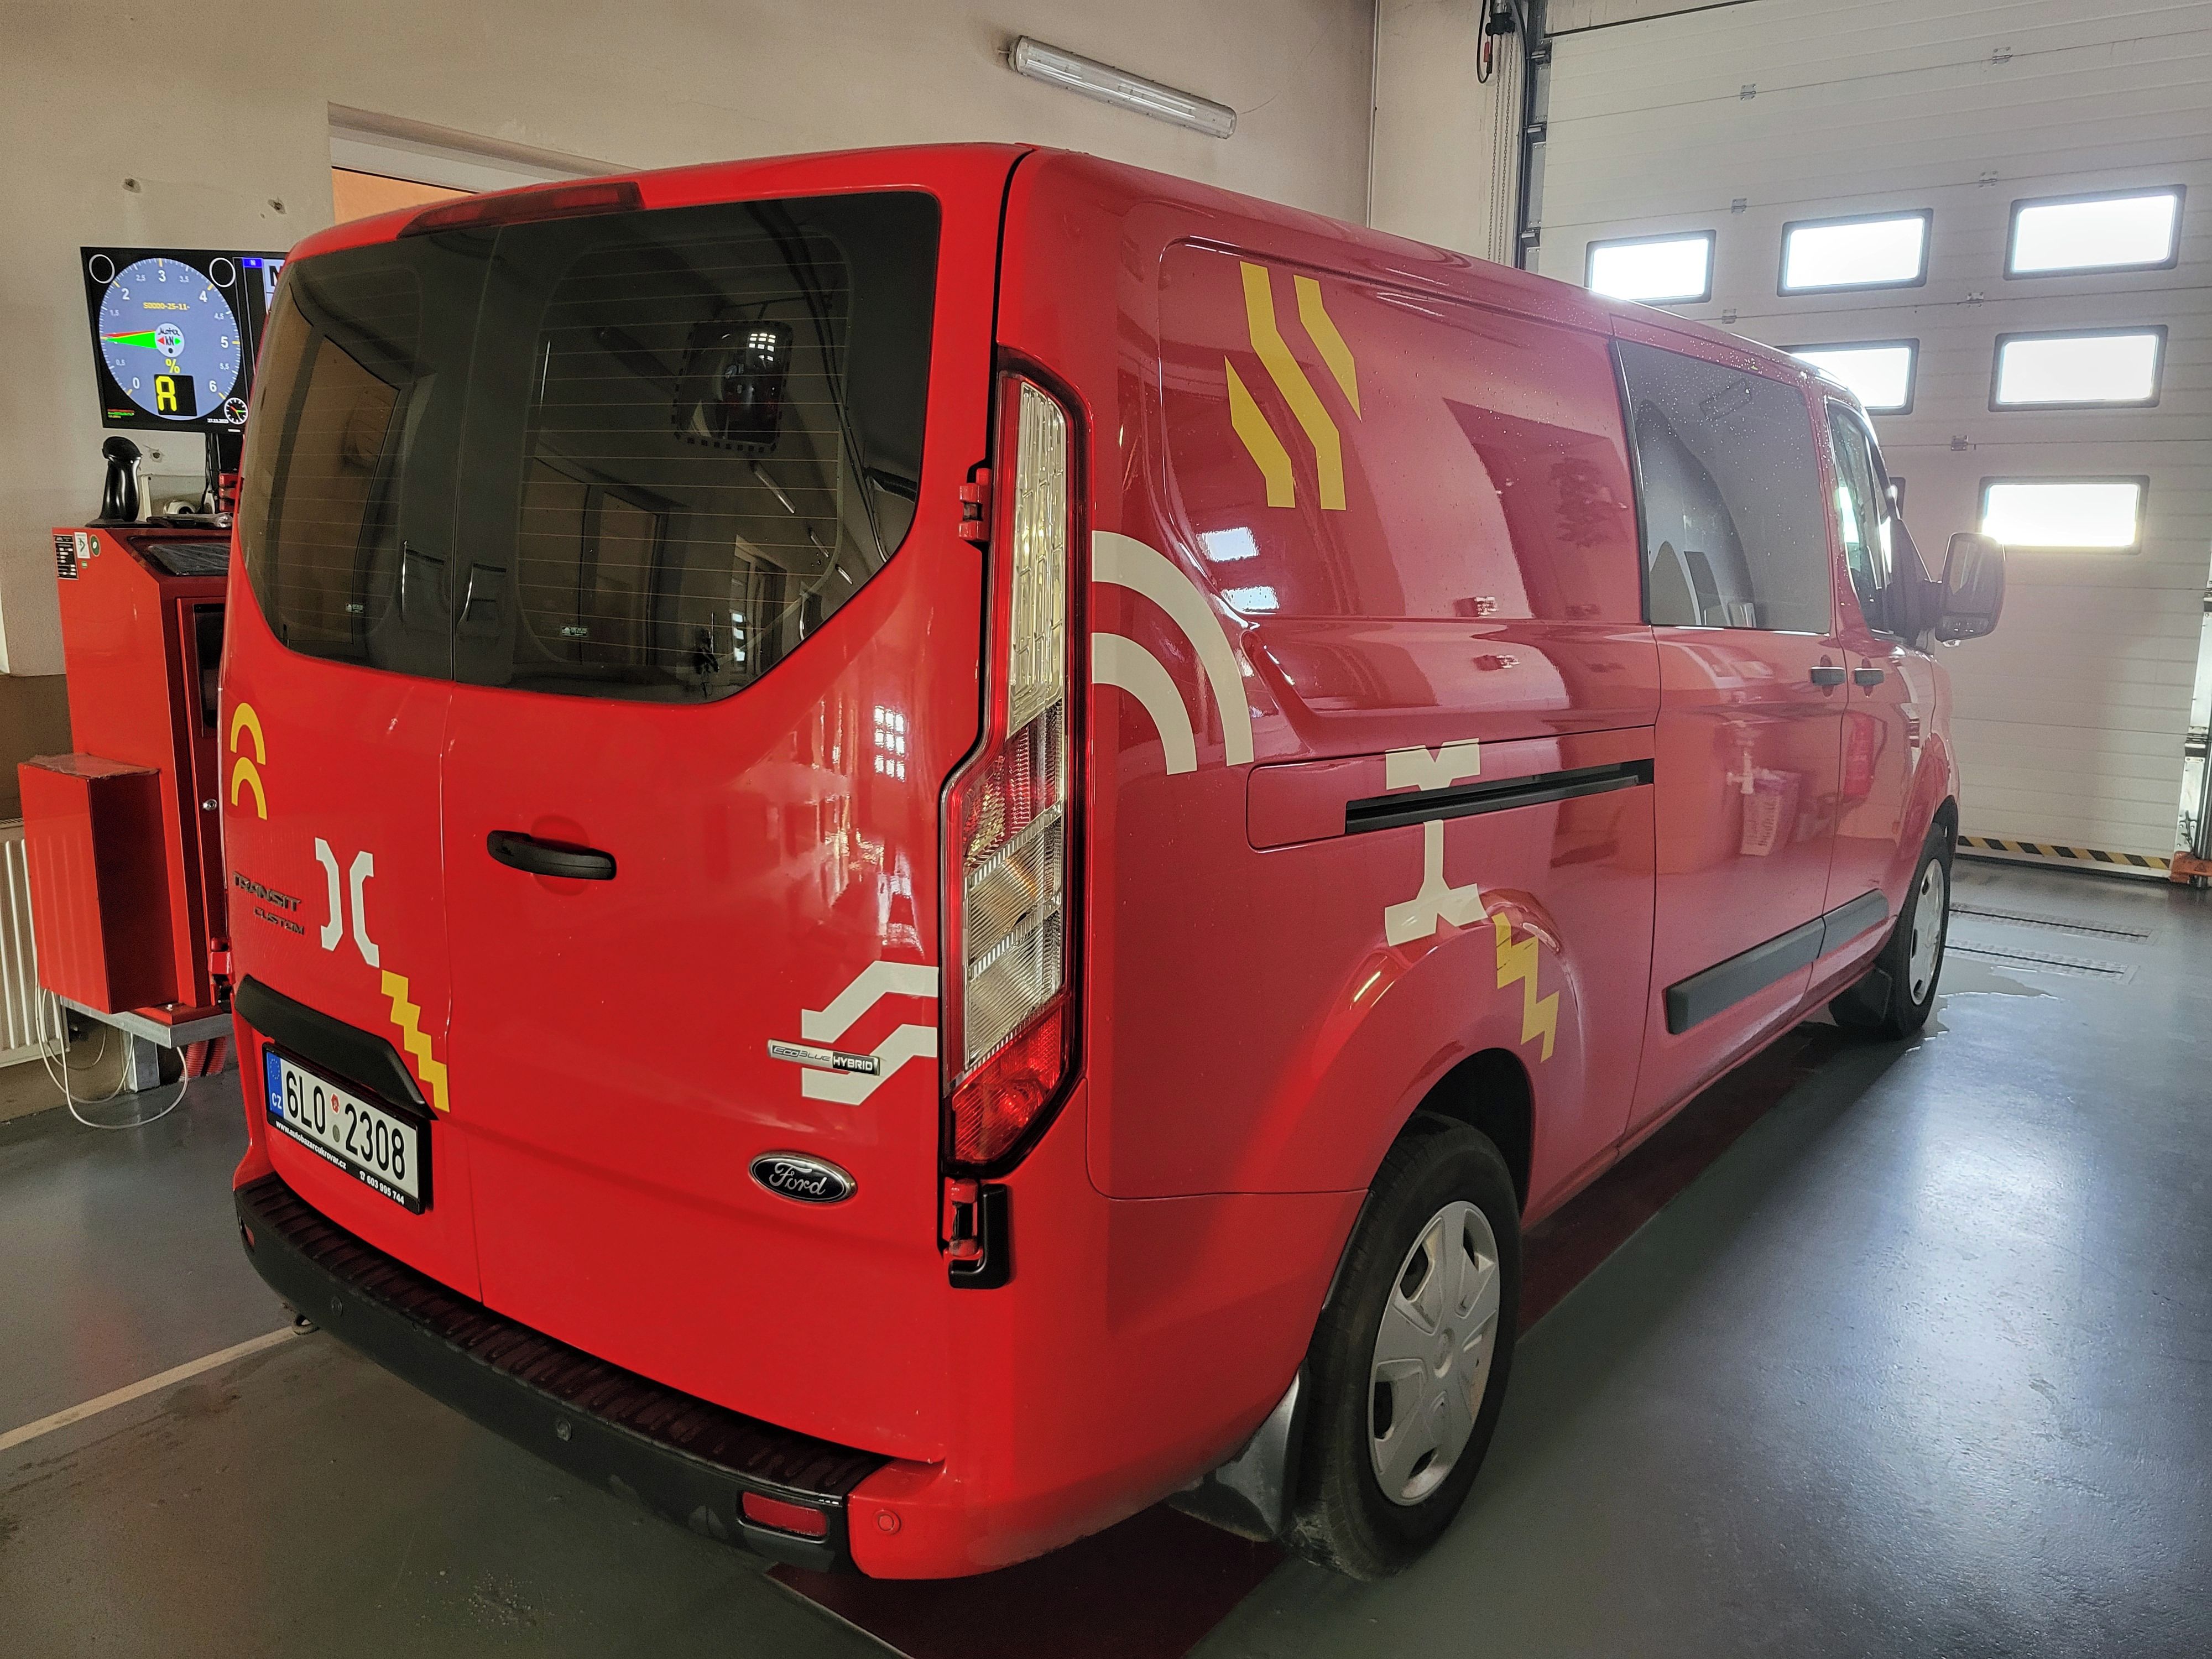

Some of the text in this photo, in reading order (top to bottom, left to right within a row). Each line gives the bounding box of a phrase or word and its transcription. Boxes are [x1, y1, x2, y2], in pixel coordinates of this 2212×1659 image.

[158, 270, 166, 282] 3
[122, 288, 130, 300] 2
[199, 290, 207, 302] 4
[165, 336, 175, 346] kN
[221, 336, 228, 348] 5
[165, 359, 180, 373] %
[132, 377, 140, 389] 0
[209, 380, 217, 392] 6
[155, 376, 177, 411] A
[232, 870, 302, 912] TRANSIT
[254, 906, 304, 936] CUSTOM
[833, 1055, 873, 1071] HYBRID
[271, 1092, 283, 1110] CZ
[275, 1120, 347, 1170] www.autobazarcukrovar.cz
[345, 1103, 405, 1180] 2308
[769, 1162, 828, 1195] Ford
[367, 1175, 405, 1205] 603 995 744
